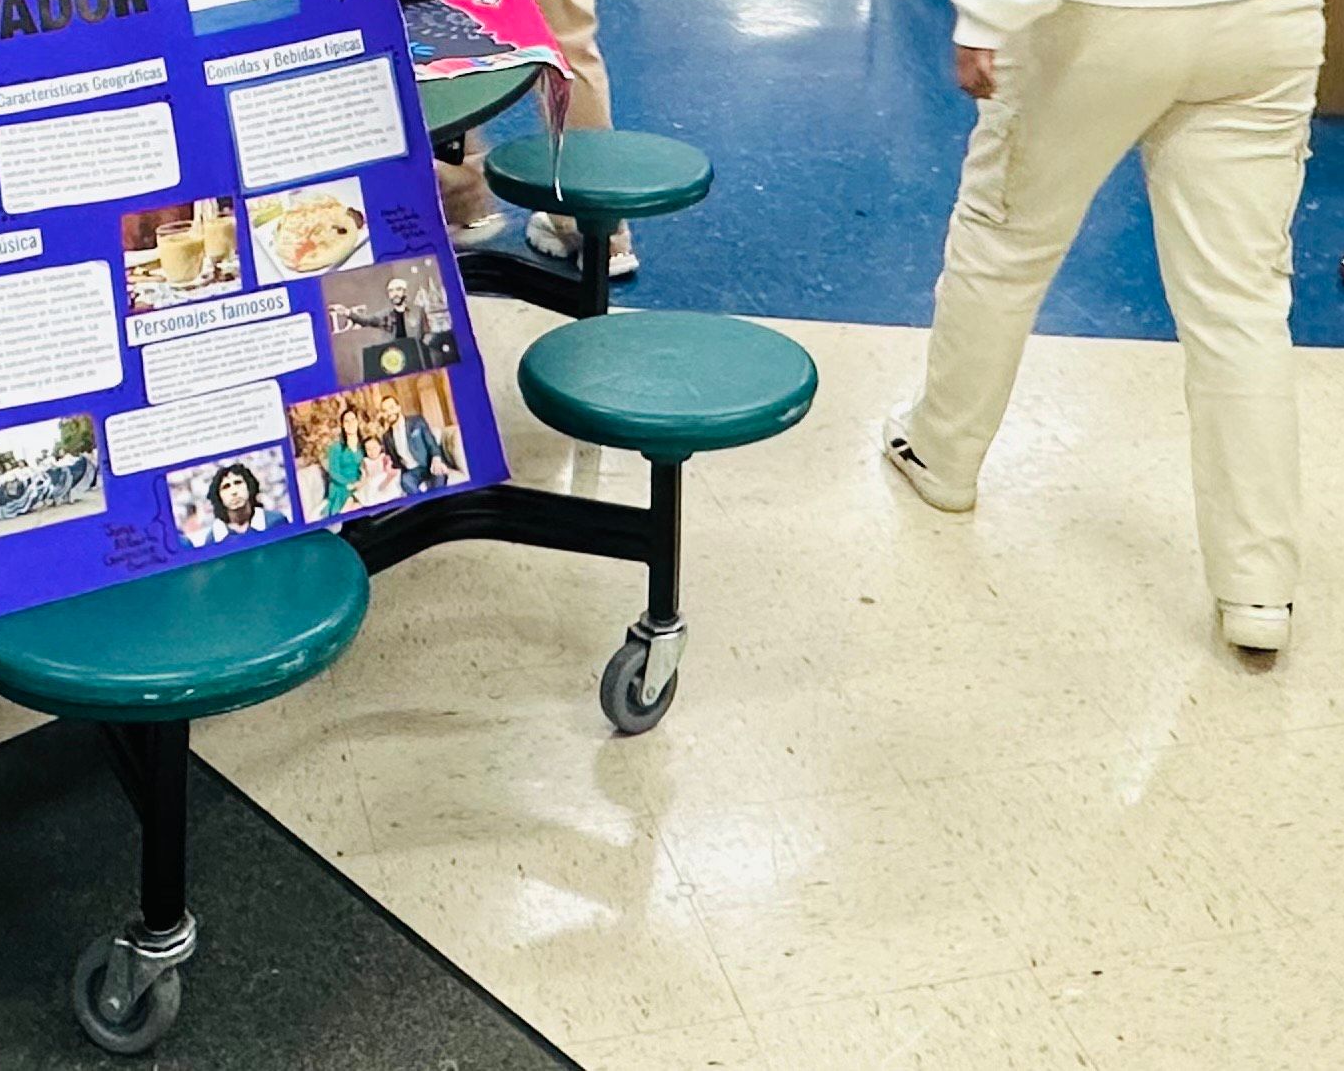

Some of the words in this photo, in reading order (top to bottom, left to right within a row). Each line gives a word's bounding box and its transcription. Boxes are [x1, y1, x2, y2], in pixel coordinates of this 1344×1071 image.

[92, 66, 163, 94] Geográficas
[206, 55, 260, 80] Comidas
[263, 59, 272, 72] y
[273, 46, 322, 68] Bebidas
[133, 309, 217, 339] Personajes
[221, 296, 285, 322] famosos
